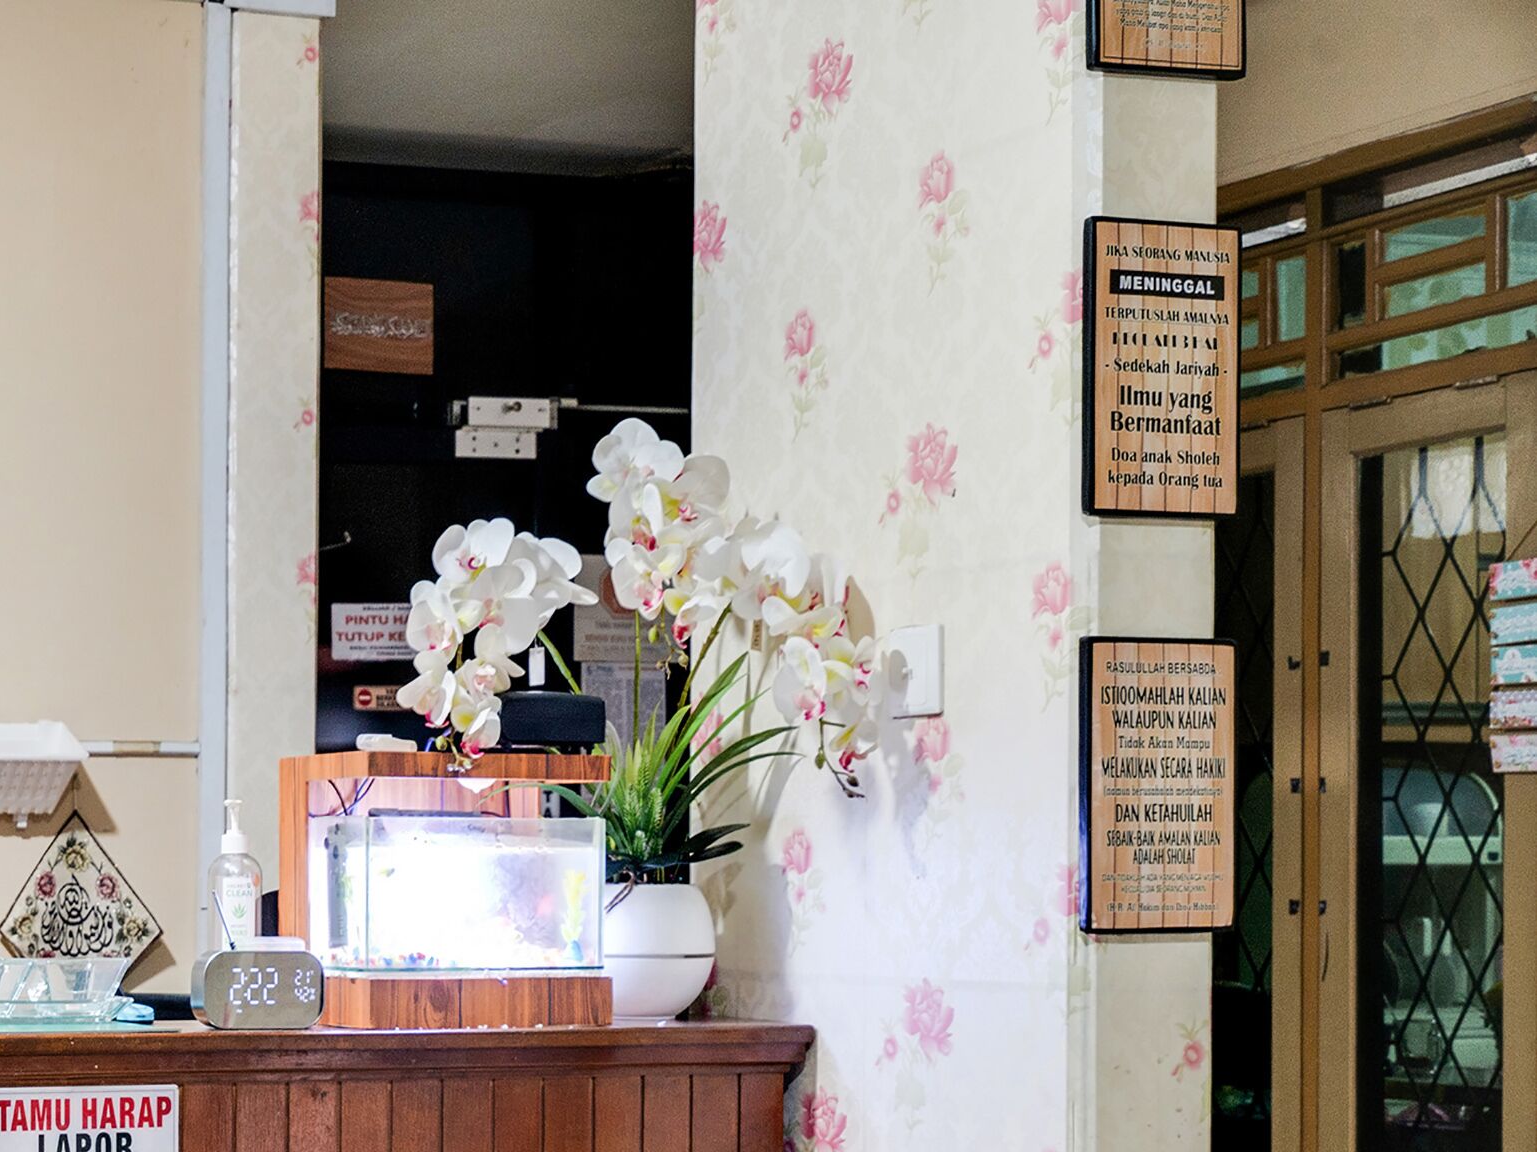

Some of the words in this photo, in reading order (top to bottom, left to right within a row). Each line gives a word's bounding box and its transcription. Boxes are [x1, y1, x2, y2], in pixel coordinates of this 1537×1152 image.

[1106, 245, 1129, 258] JIKA
[1132, 246, 1181, 261] SEORANG
[1184, 249, 1230, 264] MANUSIA
[1119, 275, 1215, 295] MENINGGAL
[1105, 306, 1180, 322] TERPUTUSLAH
[1183, 311, 1229, 325] AMALNYA
[1114, 358, 1170, 374] Sedekah
[1174, 360, 1219, 379] Jariyah
[1120, 385, 1162, 407] Ilmu
[1168, 390, 1213, 415] yang
[1110, 411, 1221, 436] Bermanfaat
[1111, 447, 1137, 462] Doa
[1141, 450, 1172, 464] anak
[1177, 449, 1220, 466] Sholeh
[1108, 469, 1154, 487] kepada
[1158, 471, 1199, 490] Orang
[1203, 474, 1223, 488] tua
[345, 614, 389, 626] PINTU
[336, 631, 385, 642] TUTUP
[1106, 661, 1165, 674] RASULULLAH
[1168, 662, 1216, 675] BERSABDA
[1101, 685, 1184, 706] ISTIQOMAHLAH
[1188, 686, 1226, 706] KALIAN
[1112, 710, 1174, 729] WALAUPUN
[1178, 710, 1216, 729] KALIAN
[1118, 735, 1145, 749] Tidak
[1148, 736, 1173, 749] Akan
[1176, 736, 1210, 752] Mampu
[1101, 756, 1157, 778] MELAKUKAN
[1160, 756, 1193, 778] SECARA
[1196, 757, 1226, 778] HAKIKI
[1115, 803, 1140, 822] DAN
[1144, 803, 1212, 822] KETAHUILAH
[1106, 830, 1155, 847] SEBAIK-BAIK
[1158, 830, 1191, 846] AMALAN
[1193, 830, 1221, 846] KALIAN
[1133, 848, 1164, 865] ADALAH
[1167, 848, 1195, 865] SHOLAT
[230, 967, 279, 1005] 2:22
[82, 1096, 172, 1129] HARAP
